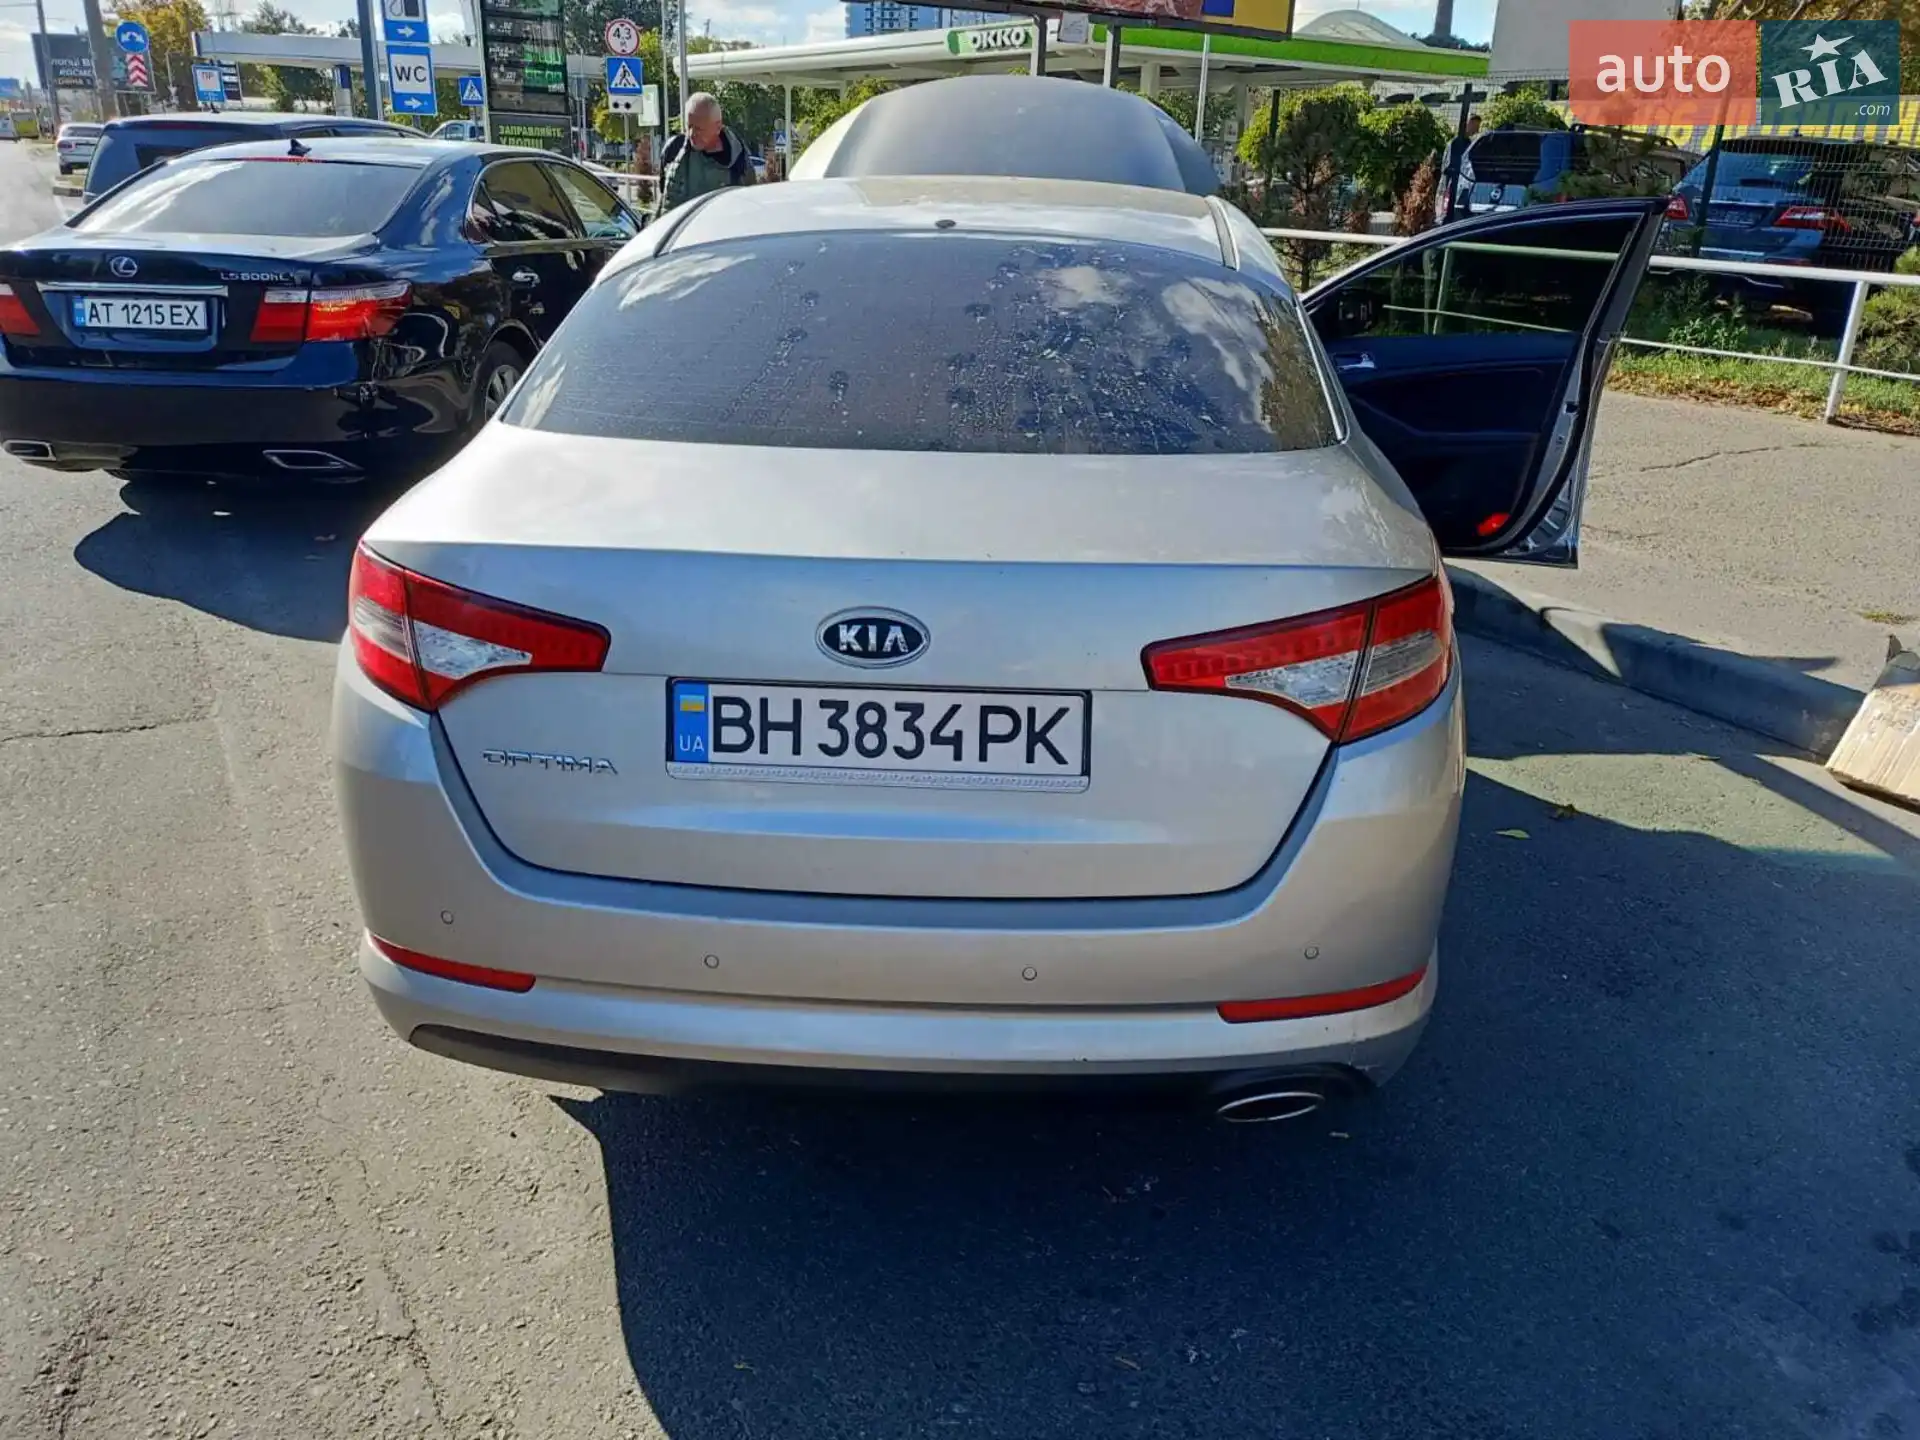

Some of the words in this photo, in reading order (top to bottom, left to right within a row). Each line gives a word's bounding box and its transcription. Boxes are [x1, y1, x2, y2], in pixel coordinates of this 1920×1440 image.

[967, 26, 1026, 49] OKKO
[394, 65, 428, 83] WC
[88, 302, 114, 324] AT
[121, 303, 165, 325] 1215
[170, 305, 199, 326] EX
[838, 624, 909, 653] KIA
[679, 734, 705, 752] UA
[712, 696, 802, 756] BH
[818, 699, 964, 762] 3834
[978, 704, 1070, 766] PK
[482, 748, 619, 776] OPTIMA
